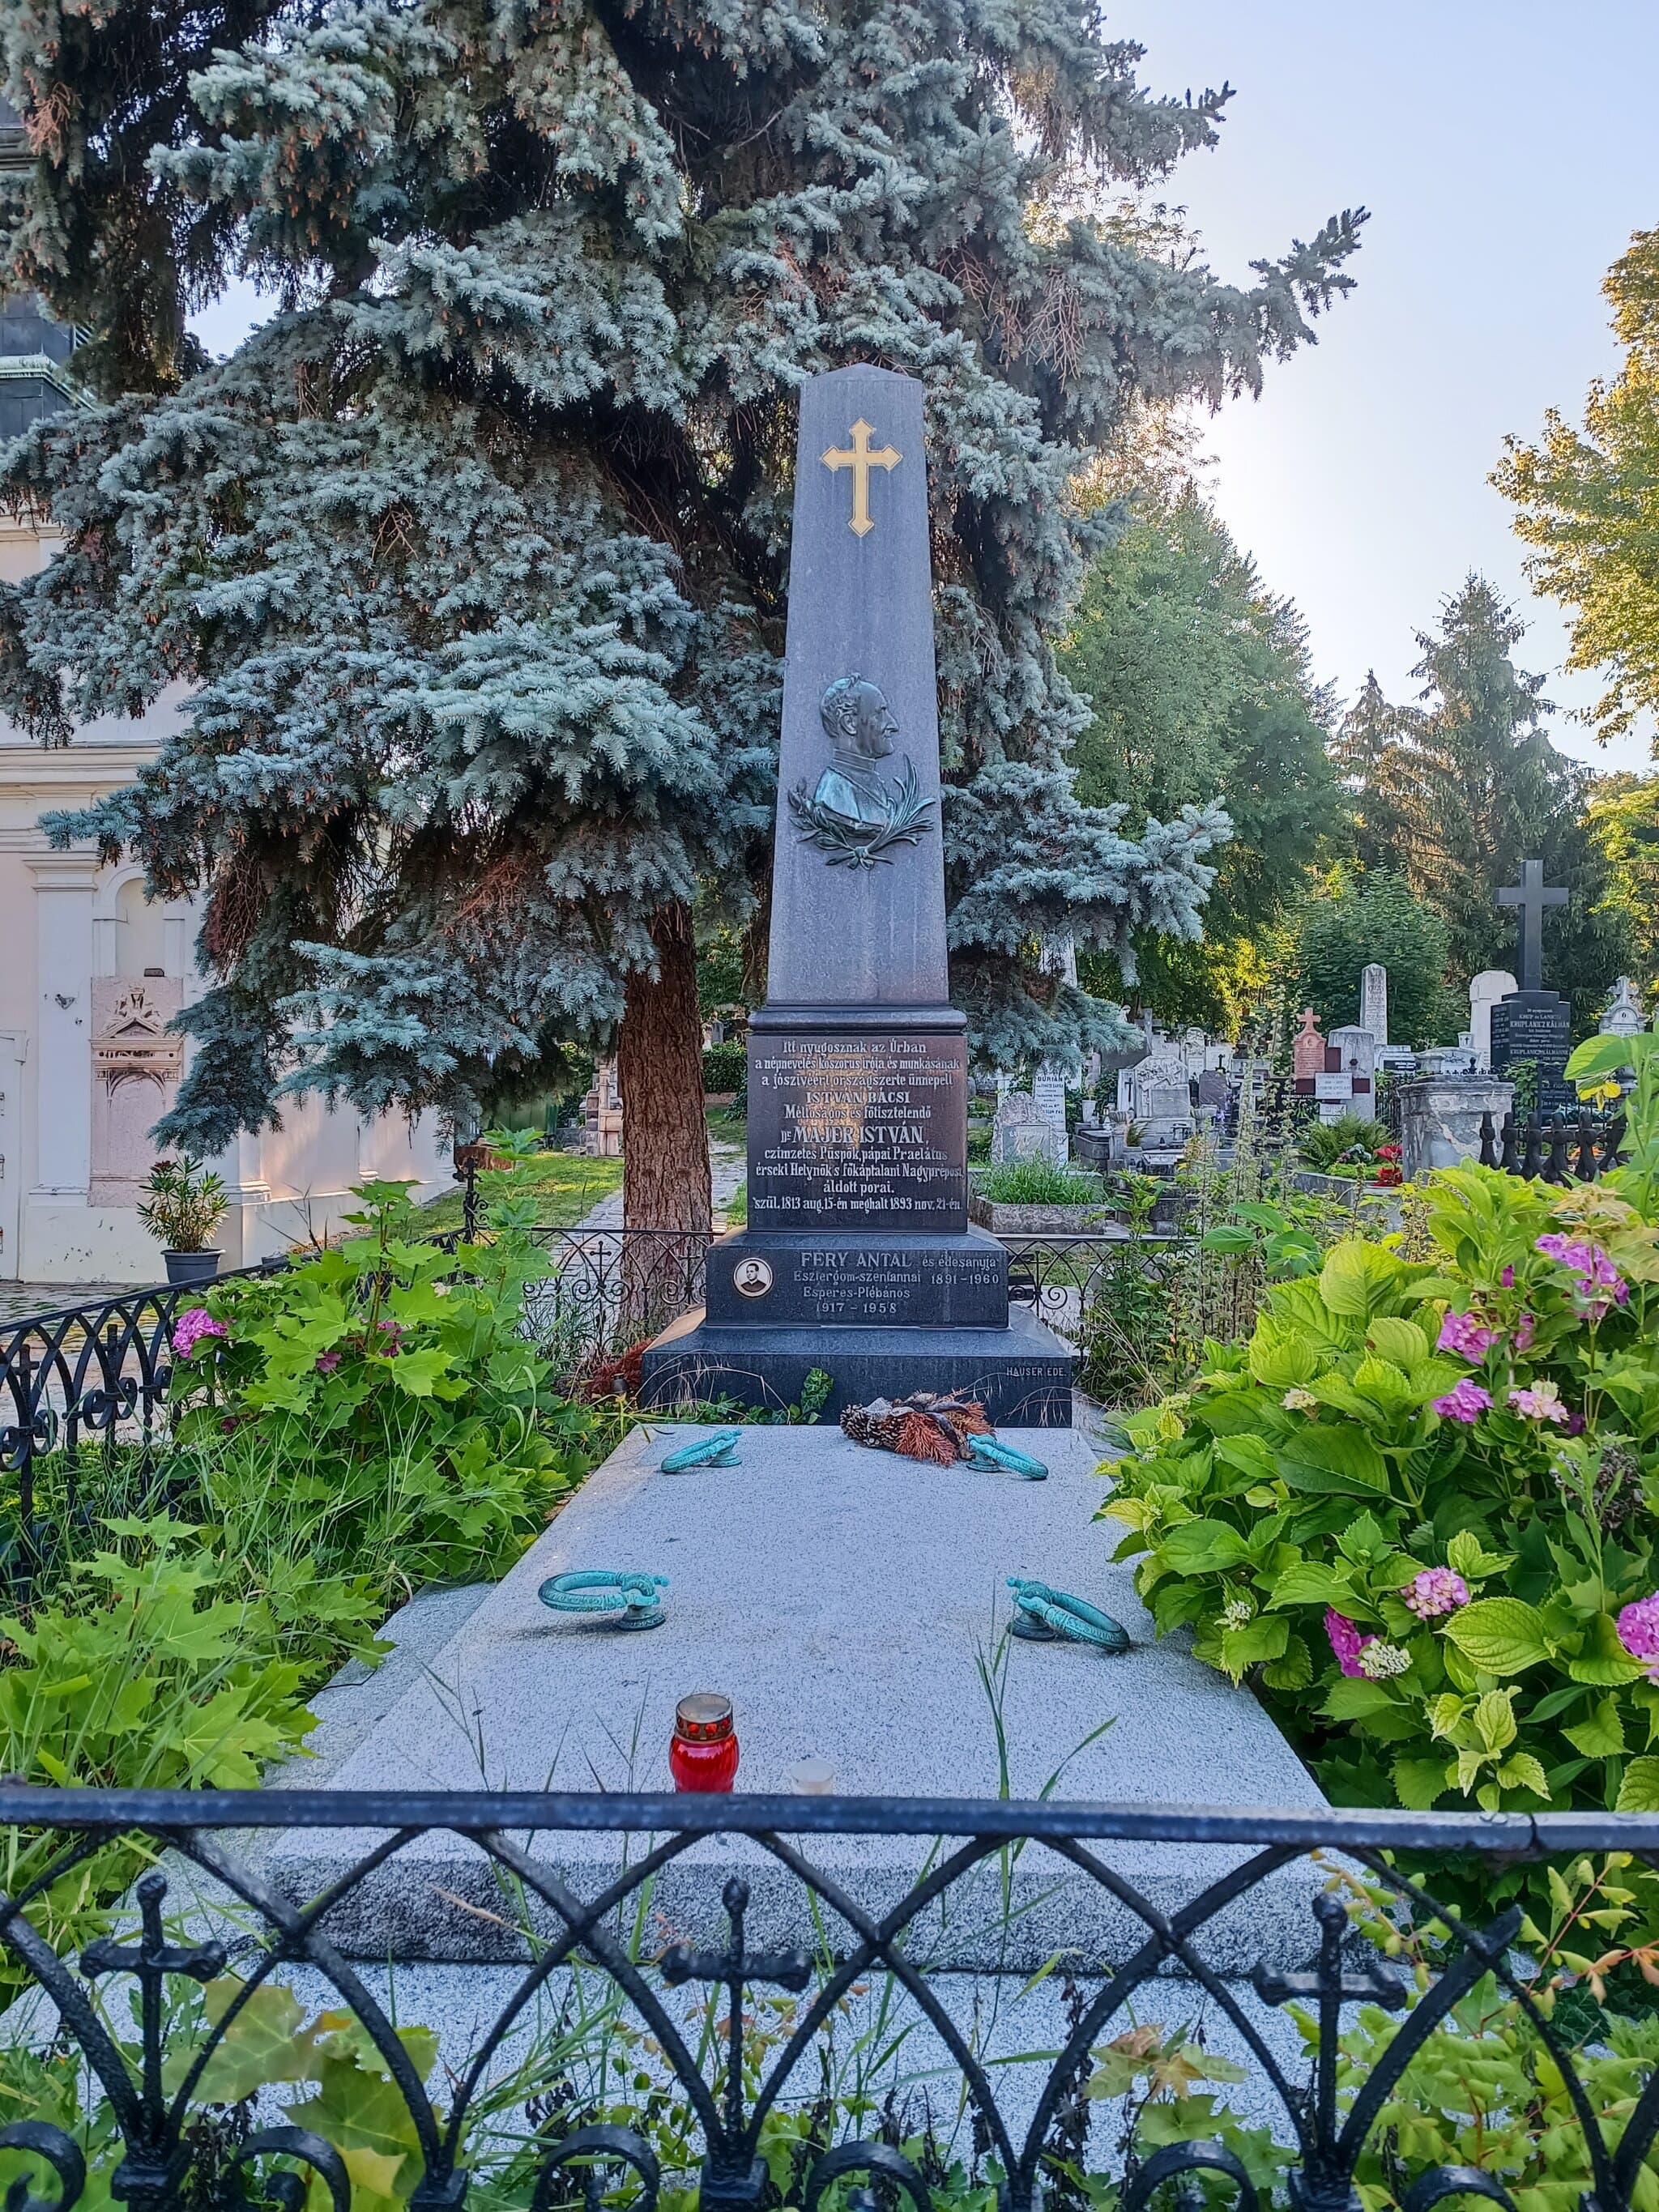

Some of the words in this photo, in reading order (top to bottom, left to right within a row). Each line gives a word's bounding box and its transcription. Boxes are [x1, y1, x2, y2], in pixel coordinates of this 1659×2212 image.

[783, 1040, 796, 1053] Itt
[800, 1041, 868, 1057] nyugosznak
[872, 1043, 885, 1053] az
[755, 1059, 762, 1069] a
[764, 1056, 817, 1073] népnevelés
[887, 1056, 898, 1069] és
[899, 1056, 960, 1069] munkásának
[761, 1076, 770, 1086] a
[806, 1087, 863, 1103] ISTVÁN
[868, 1086, 911, 1103] BÁCSI
[850, 1106, 861, 1119] és
[792, 1126, 855, 1144] MAJER
[764, 1146, 817, 1159] czimzetes
[892, 1146, 948, 1160] Praelátus
[756, 1161, 789, 1176] érseki
[823, 1179, 857, 1193] áldott
[859, 1181, 895, 1197] porai.
[781, 1196, 801, 1210] 1813
[850, 1197, 889, 1214] meghalt
[890, 1197, 913, 1210] 1893
[914, 1200, 936, 1210] nov.
[801, 1251, 849, 1267] FERY
[856, 1251, 912, 1267] ANTAL
[922, 1255, 934, 1268] és
[938, 1254, 996, 1271] édesanyja
[816, 1302, 845, 1313] 1917
[864, 1302, 897, 1313] 1958
[1006, 1366, 1043, 1377] HAUSER
